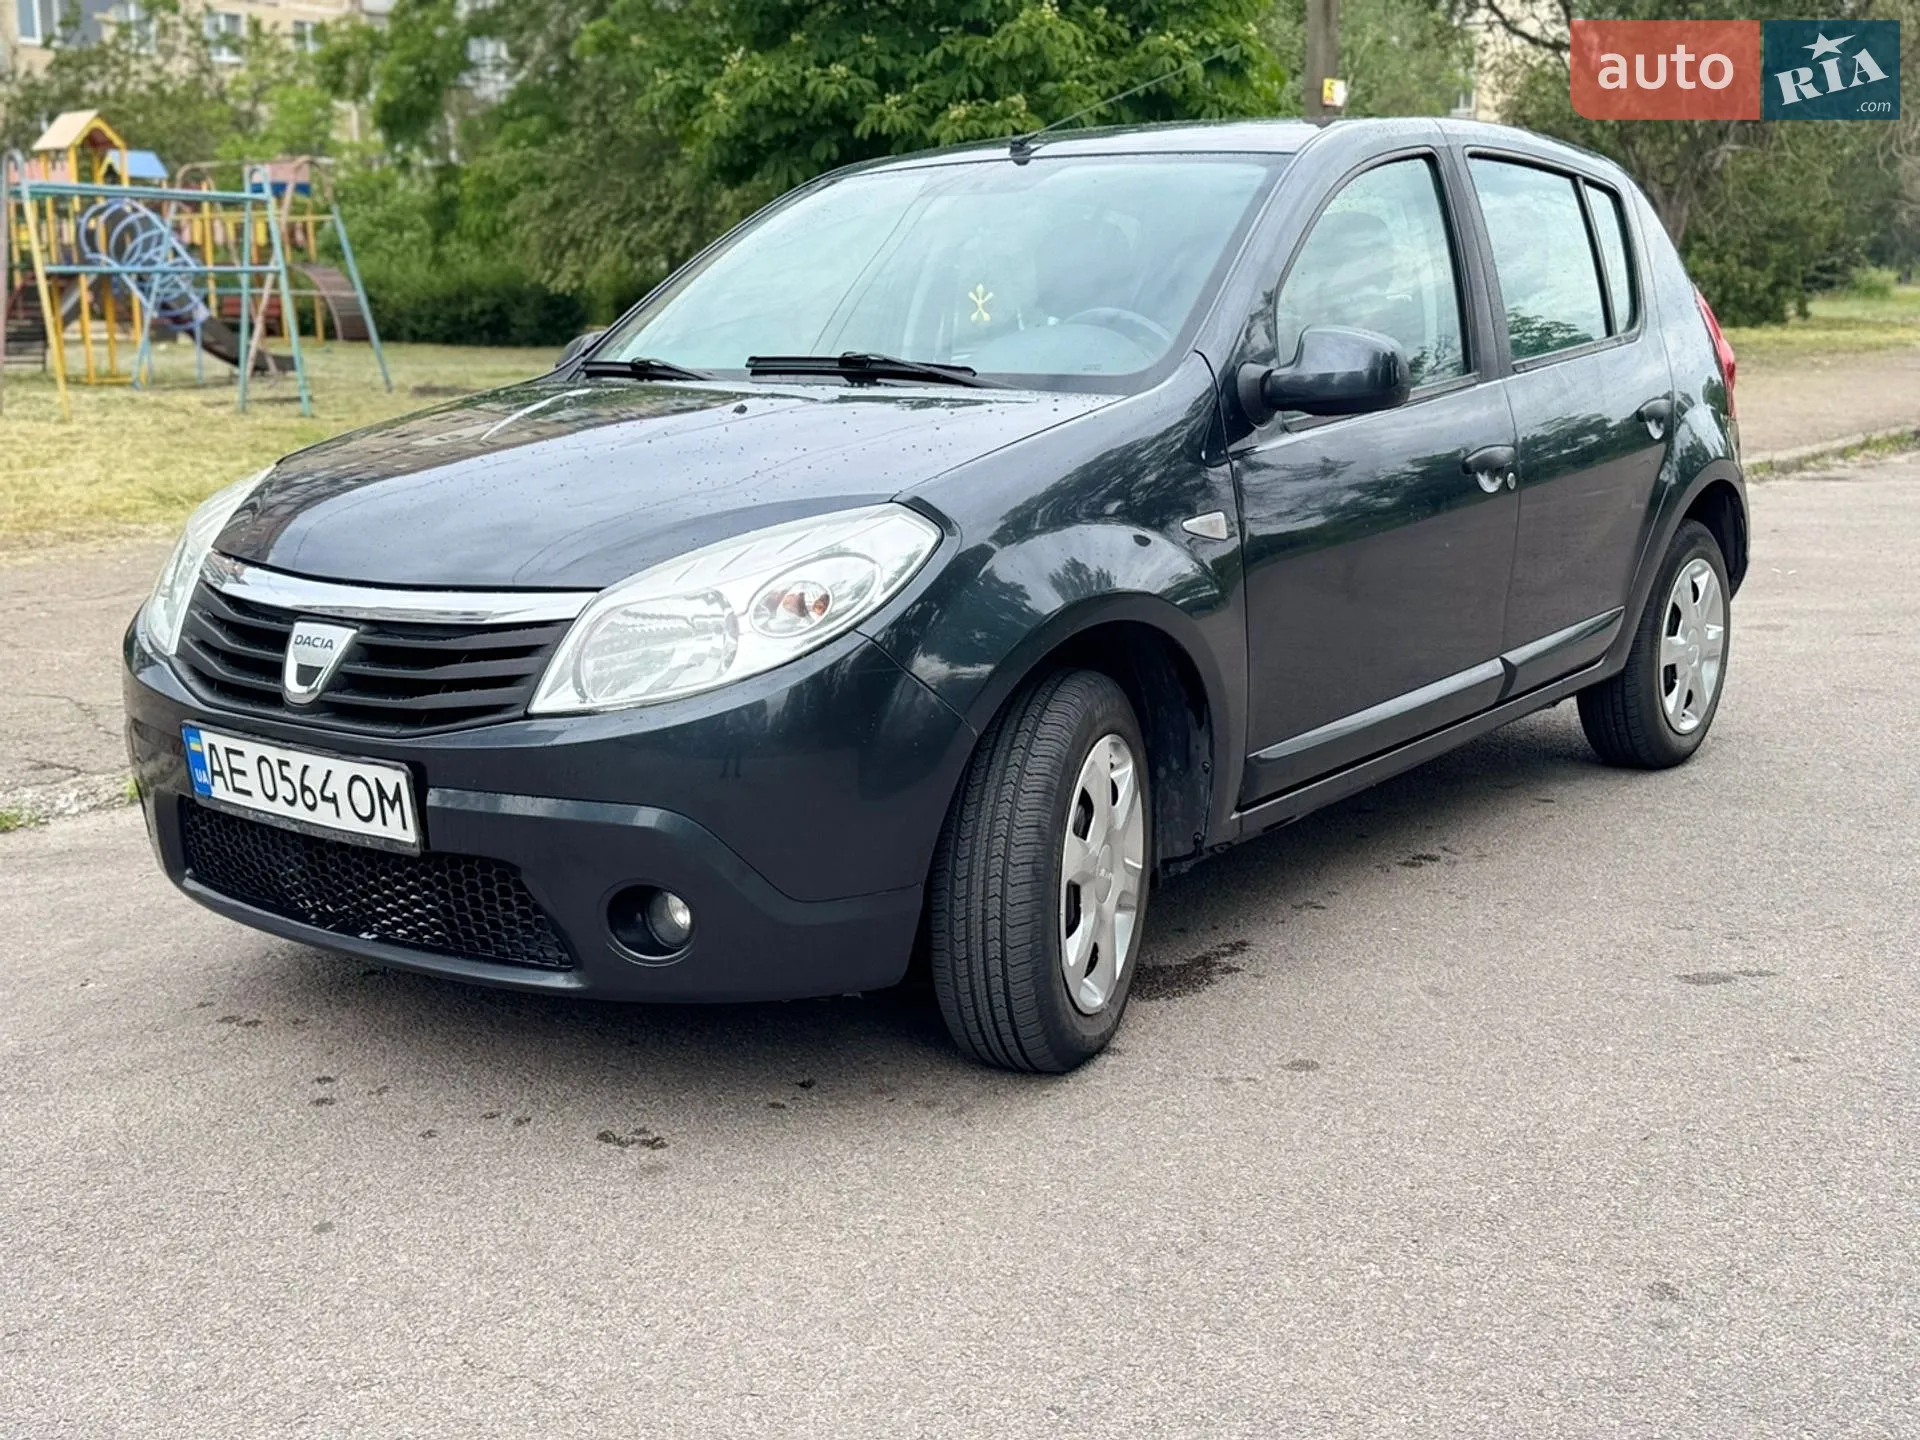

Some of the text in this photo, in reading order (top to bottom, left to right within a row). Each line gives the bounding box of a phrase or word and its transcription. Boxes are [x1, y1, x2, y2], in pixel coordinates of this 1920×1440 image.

[294, 634, 334, 651] DACIA
[195, 768, 209, 784] UA
[208, 743, 407, 831] AE 0564 OM
